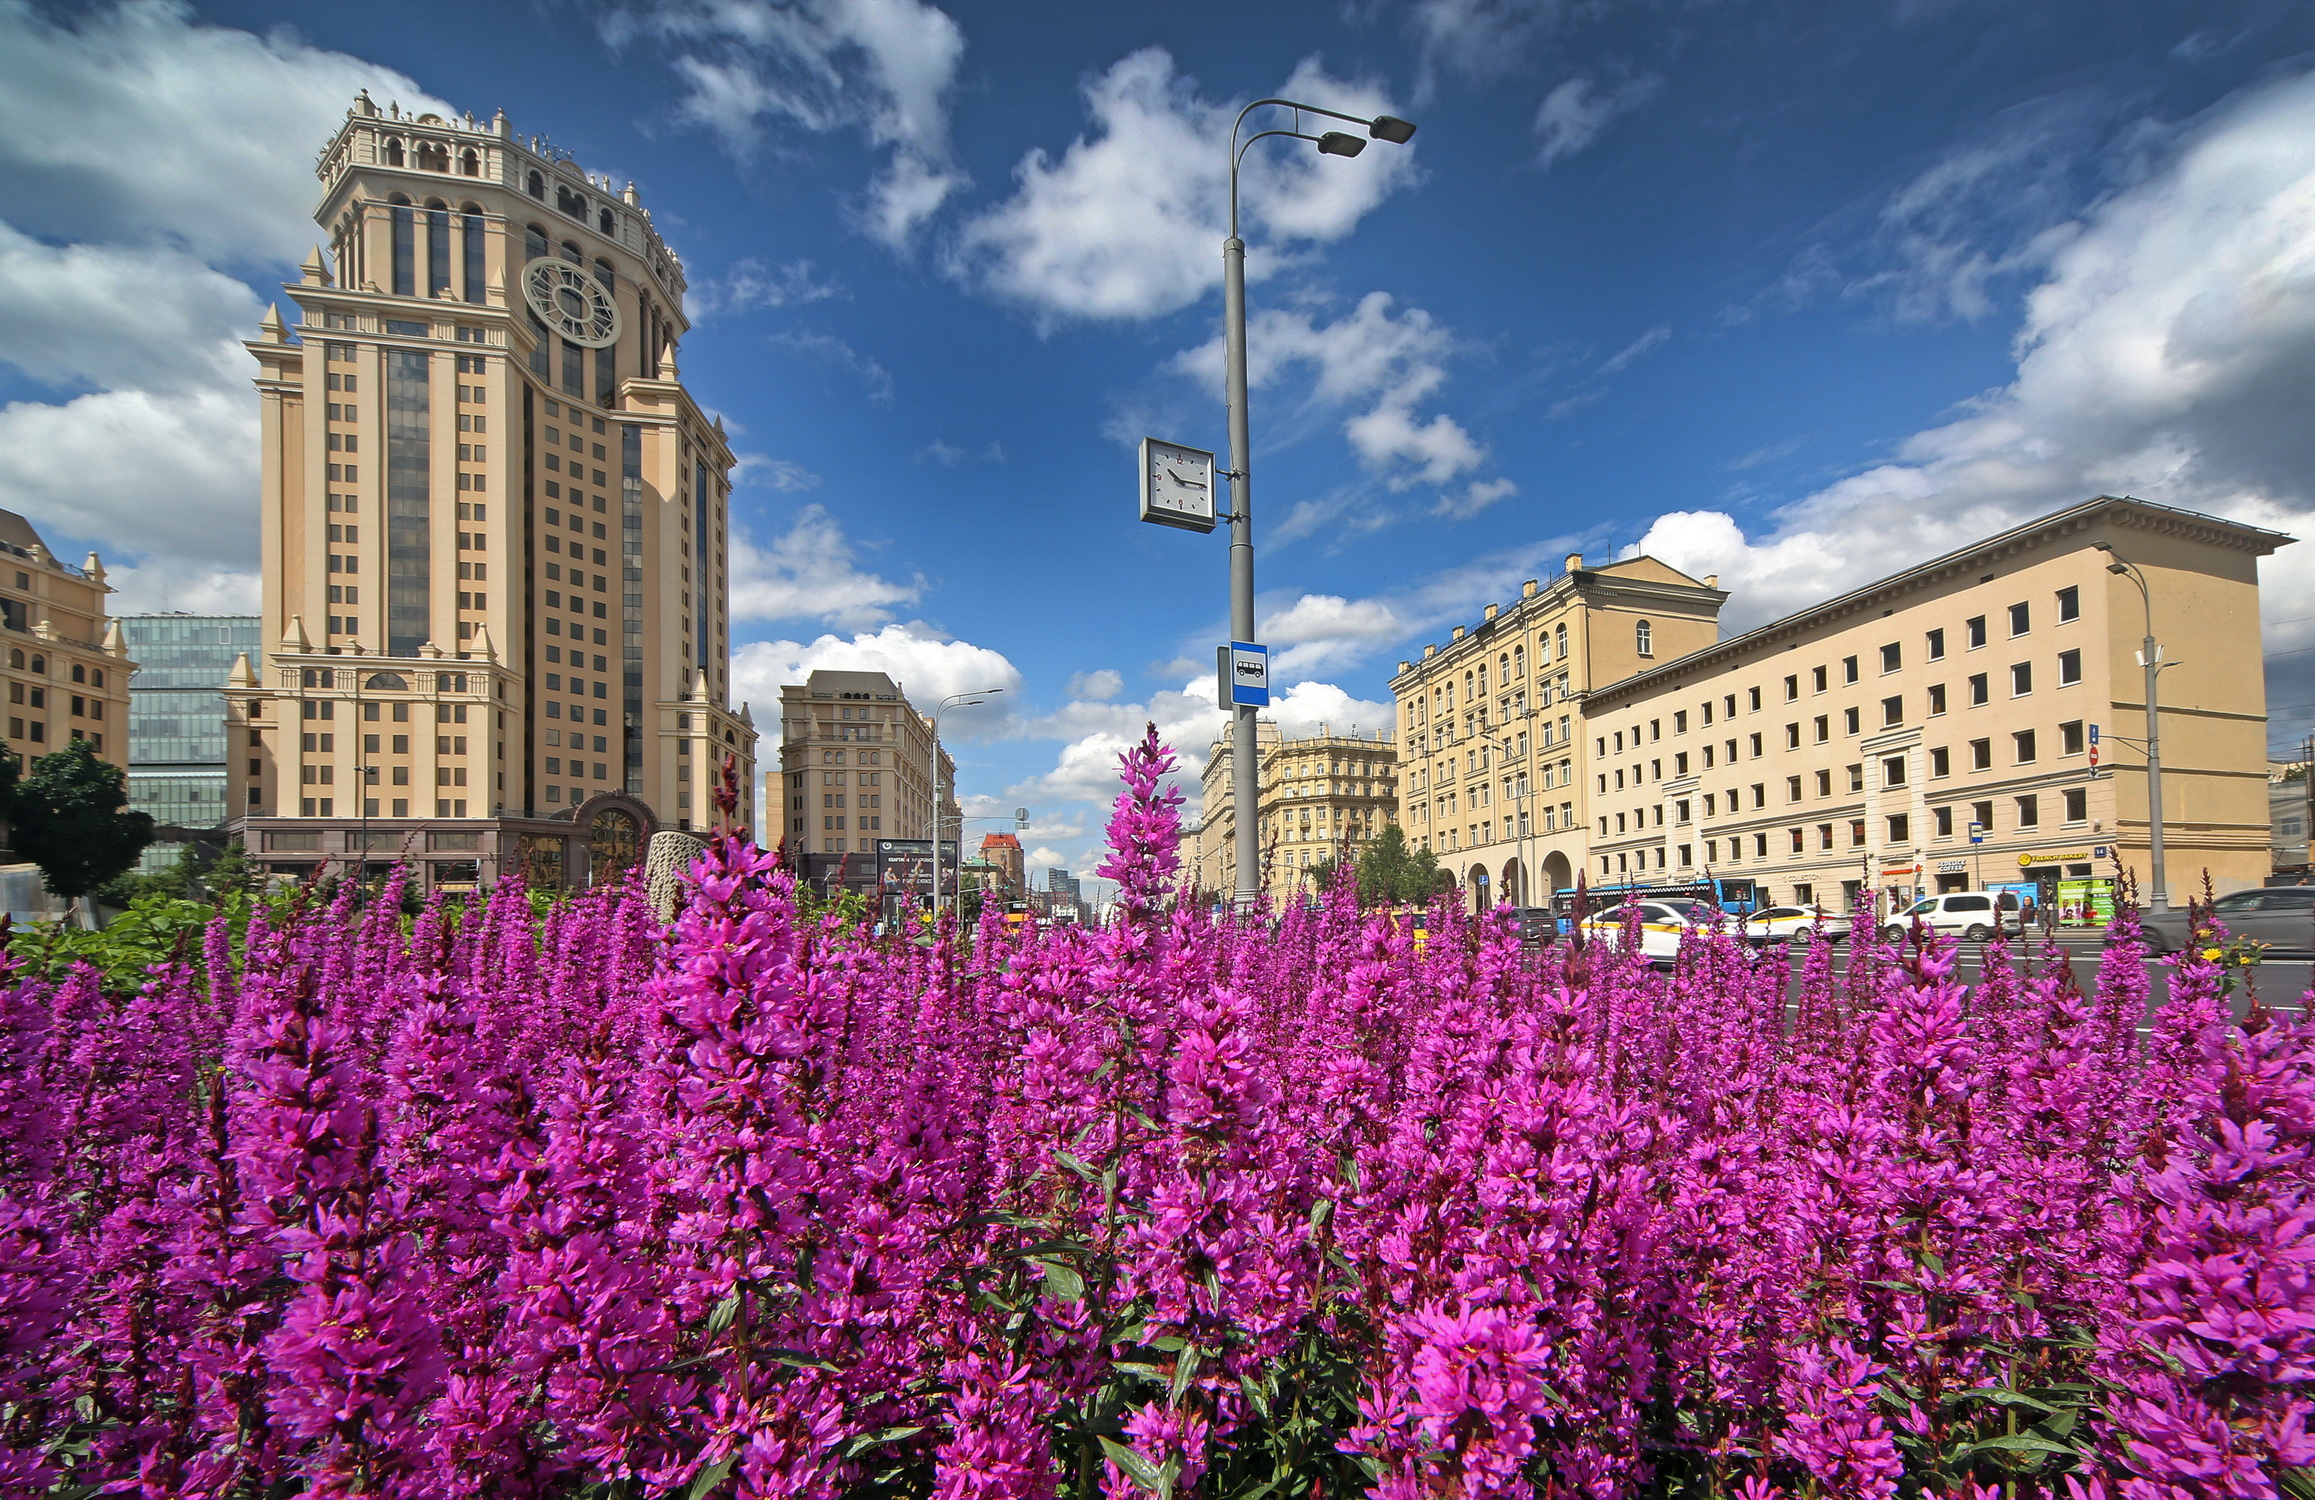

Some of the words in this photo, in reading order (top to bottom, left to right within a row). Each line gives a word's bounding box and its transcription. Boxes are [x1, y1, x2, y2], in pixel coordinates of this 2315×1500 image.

[2032, 855, 2059, 863] FRENCH
[2060, 853, 2088, 861] BAKERY
[1788, 873, 1822, 882] COLLECTION
